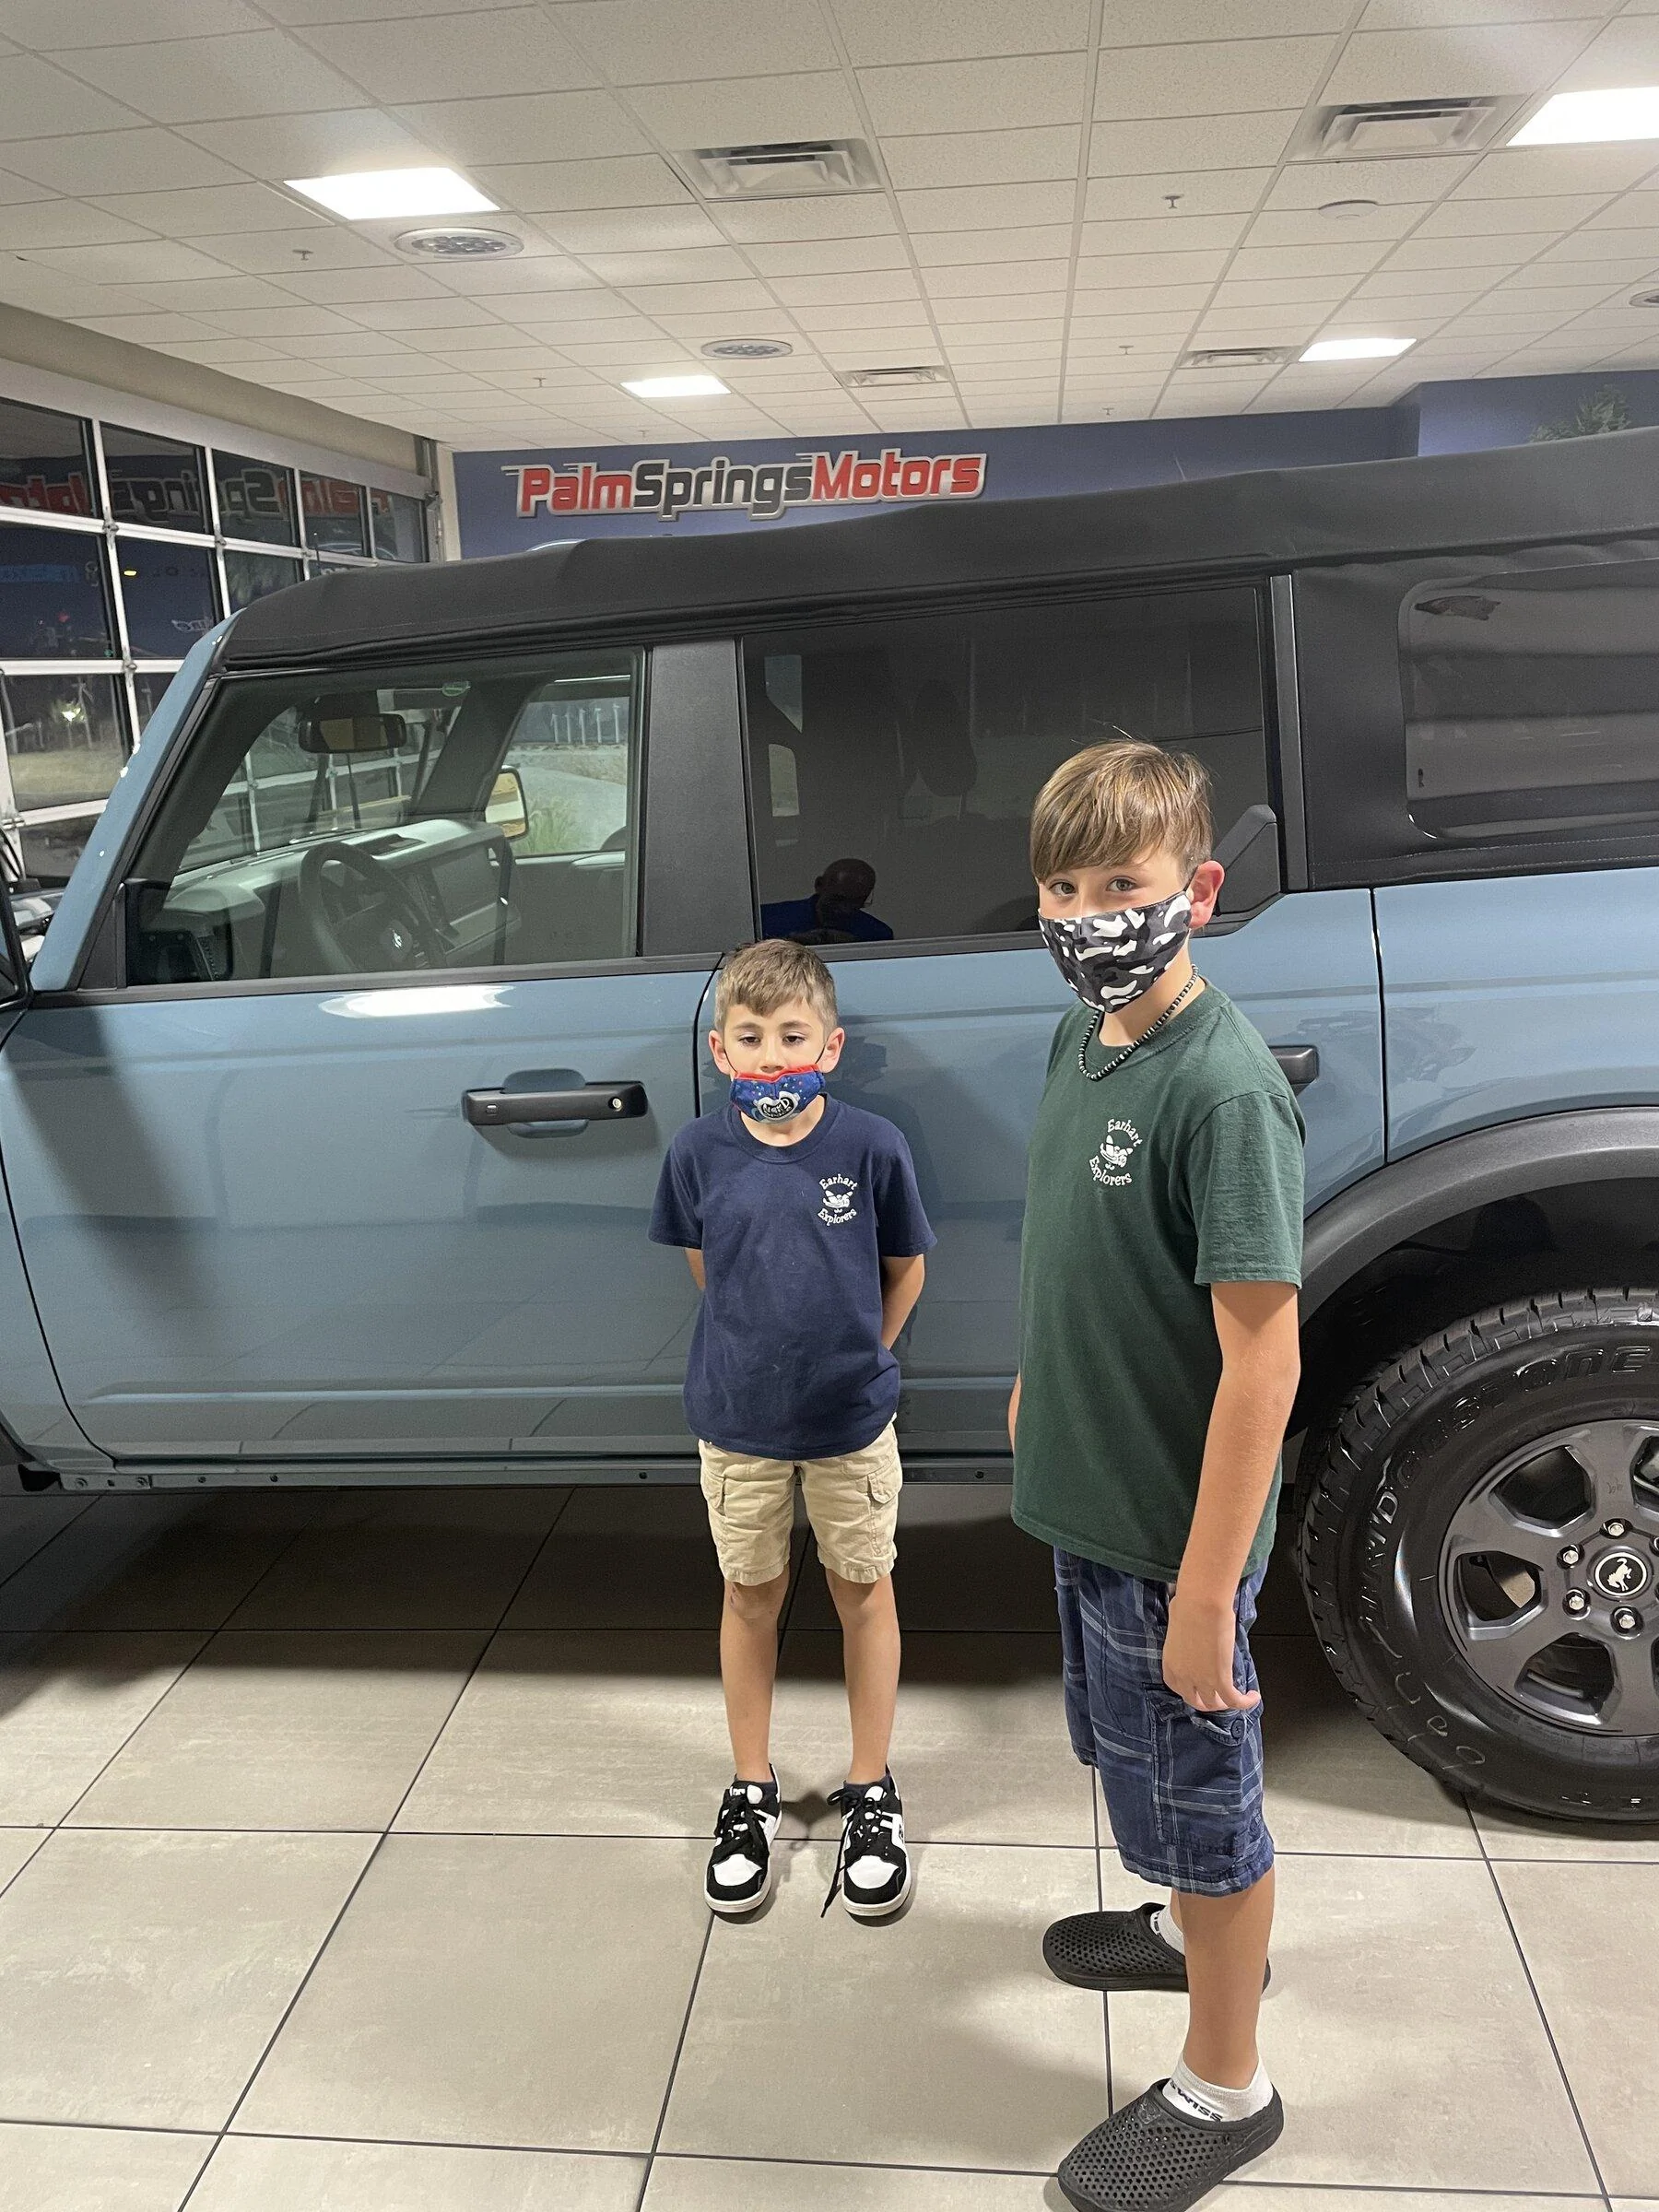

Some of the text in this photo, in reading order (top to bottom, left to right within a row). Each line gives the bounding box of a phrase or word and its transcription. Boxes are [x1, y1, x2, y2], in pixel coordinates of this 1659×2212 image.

[1106, 1118, 1143, 1147] Earhart
[818, 1173, 858, 1191] Earhart
[1088, 1154, 1133, 1186] Explorers
[817, 1207, 857, 1227] Explorers
